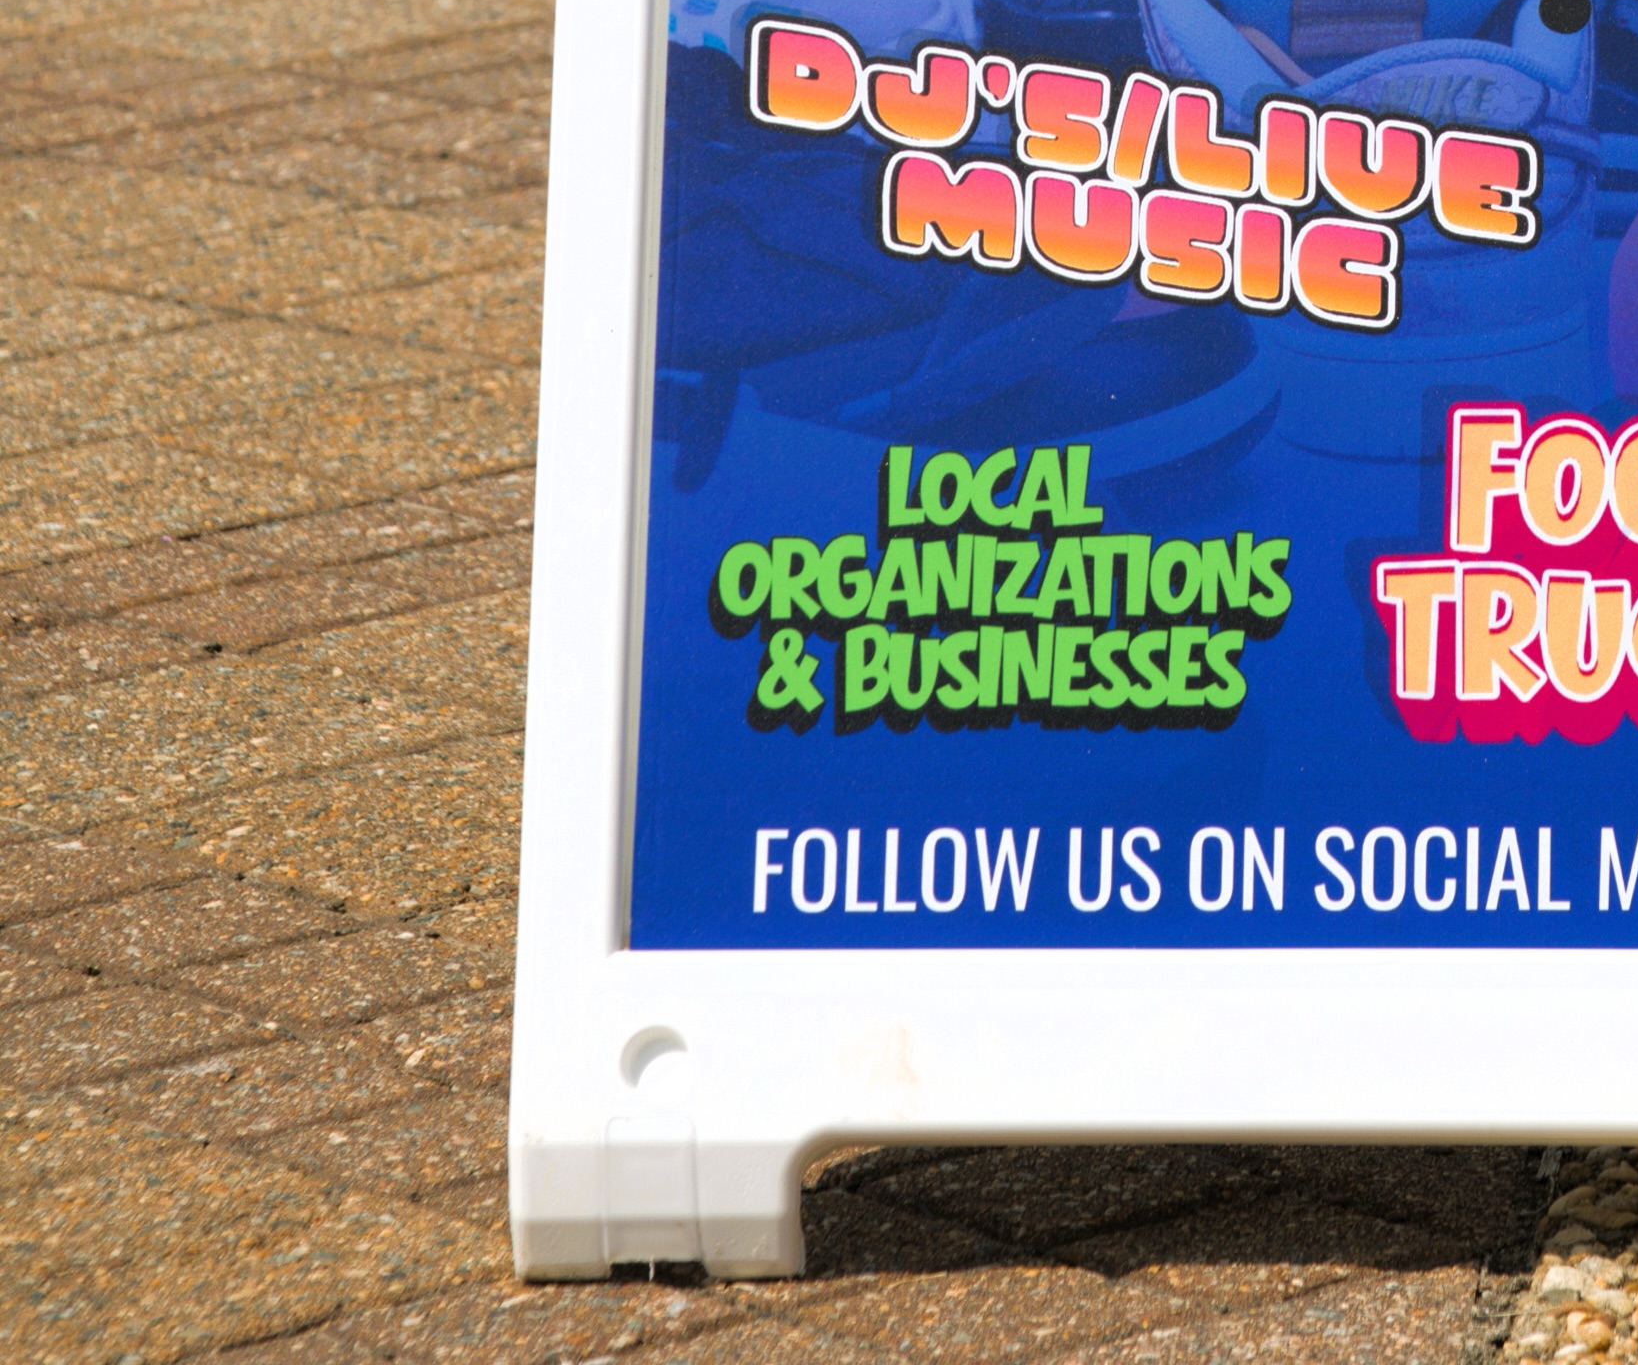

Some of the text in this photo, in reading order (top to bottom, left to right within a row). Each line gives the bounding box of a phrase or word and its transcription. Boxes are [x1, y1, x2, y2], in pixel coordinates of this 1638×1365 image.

[748, 20, 1538, 245] DJ'S/LIVE
[881, 150, 1399, 328] MUSIC
[886, 442, 1104, 530] LOCAL
[717, 531, 1293, 622] ORGANIZATIONS
[756, 622, 1248, 714] & BUSINESSES
[752, 826, 1041, 914] FOLLOW
[1068, 826, 1163, 912] US
[1187, 826, 1286, 912] ON
[1313, 826, 1571, 913] SOCIAL
